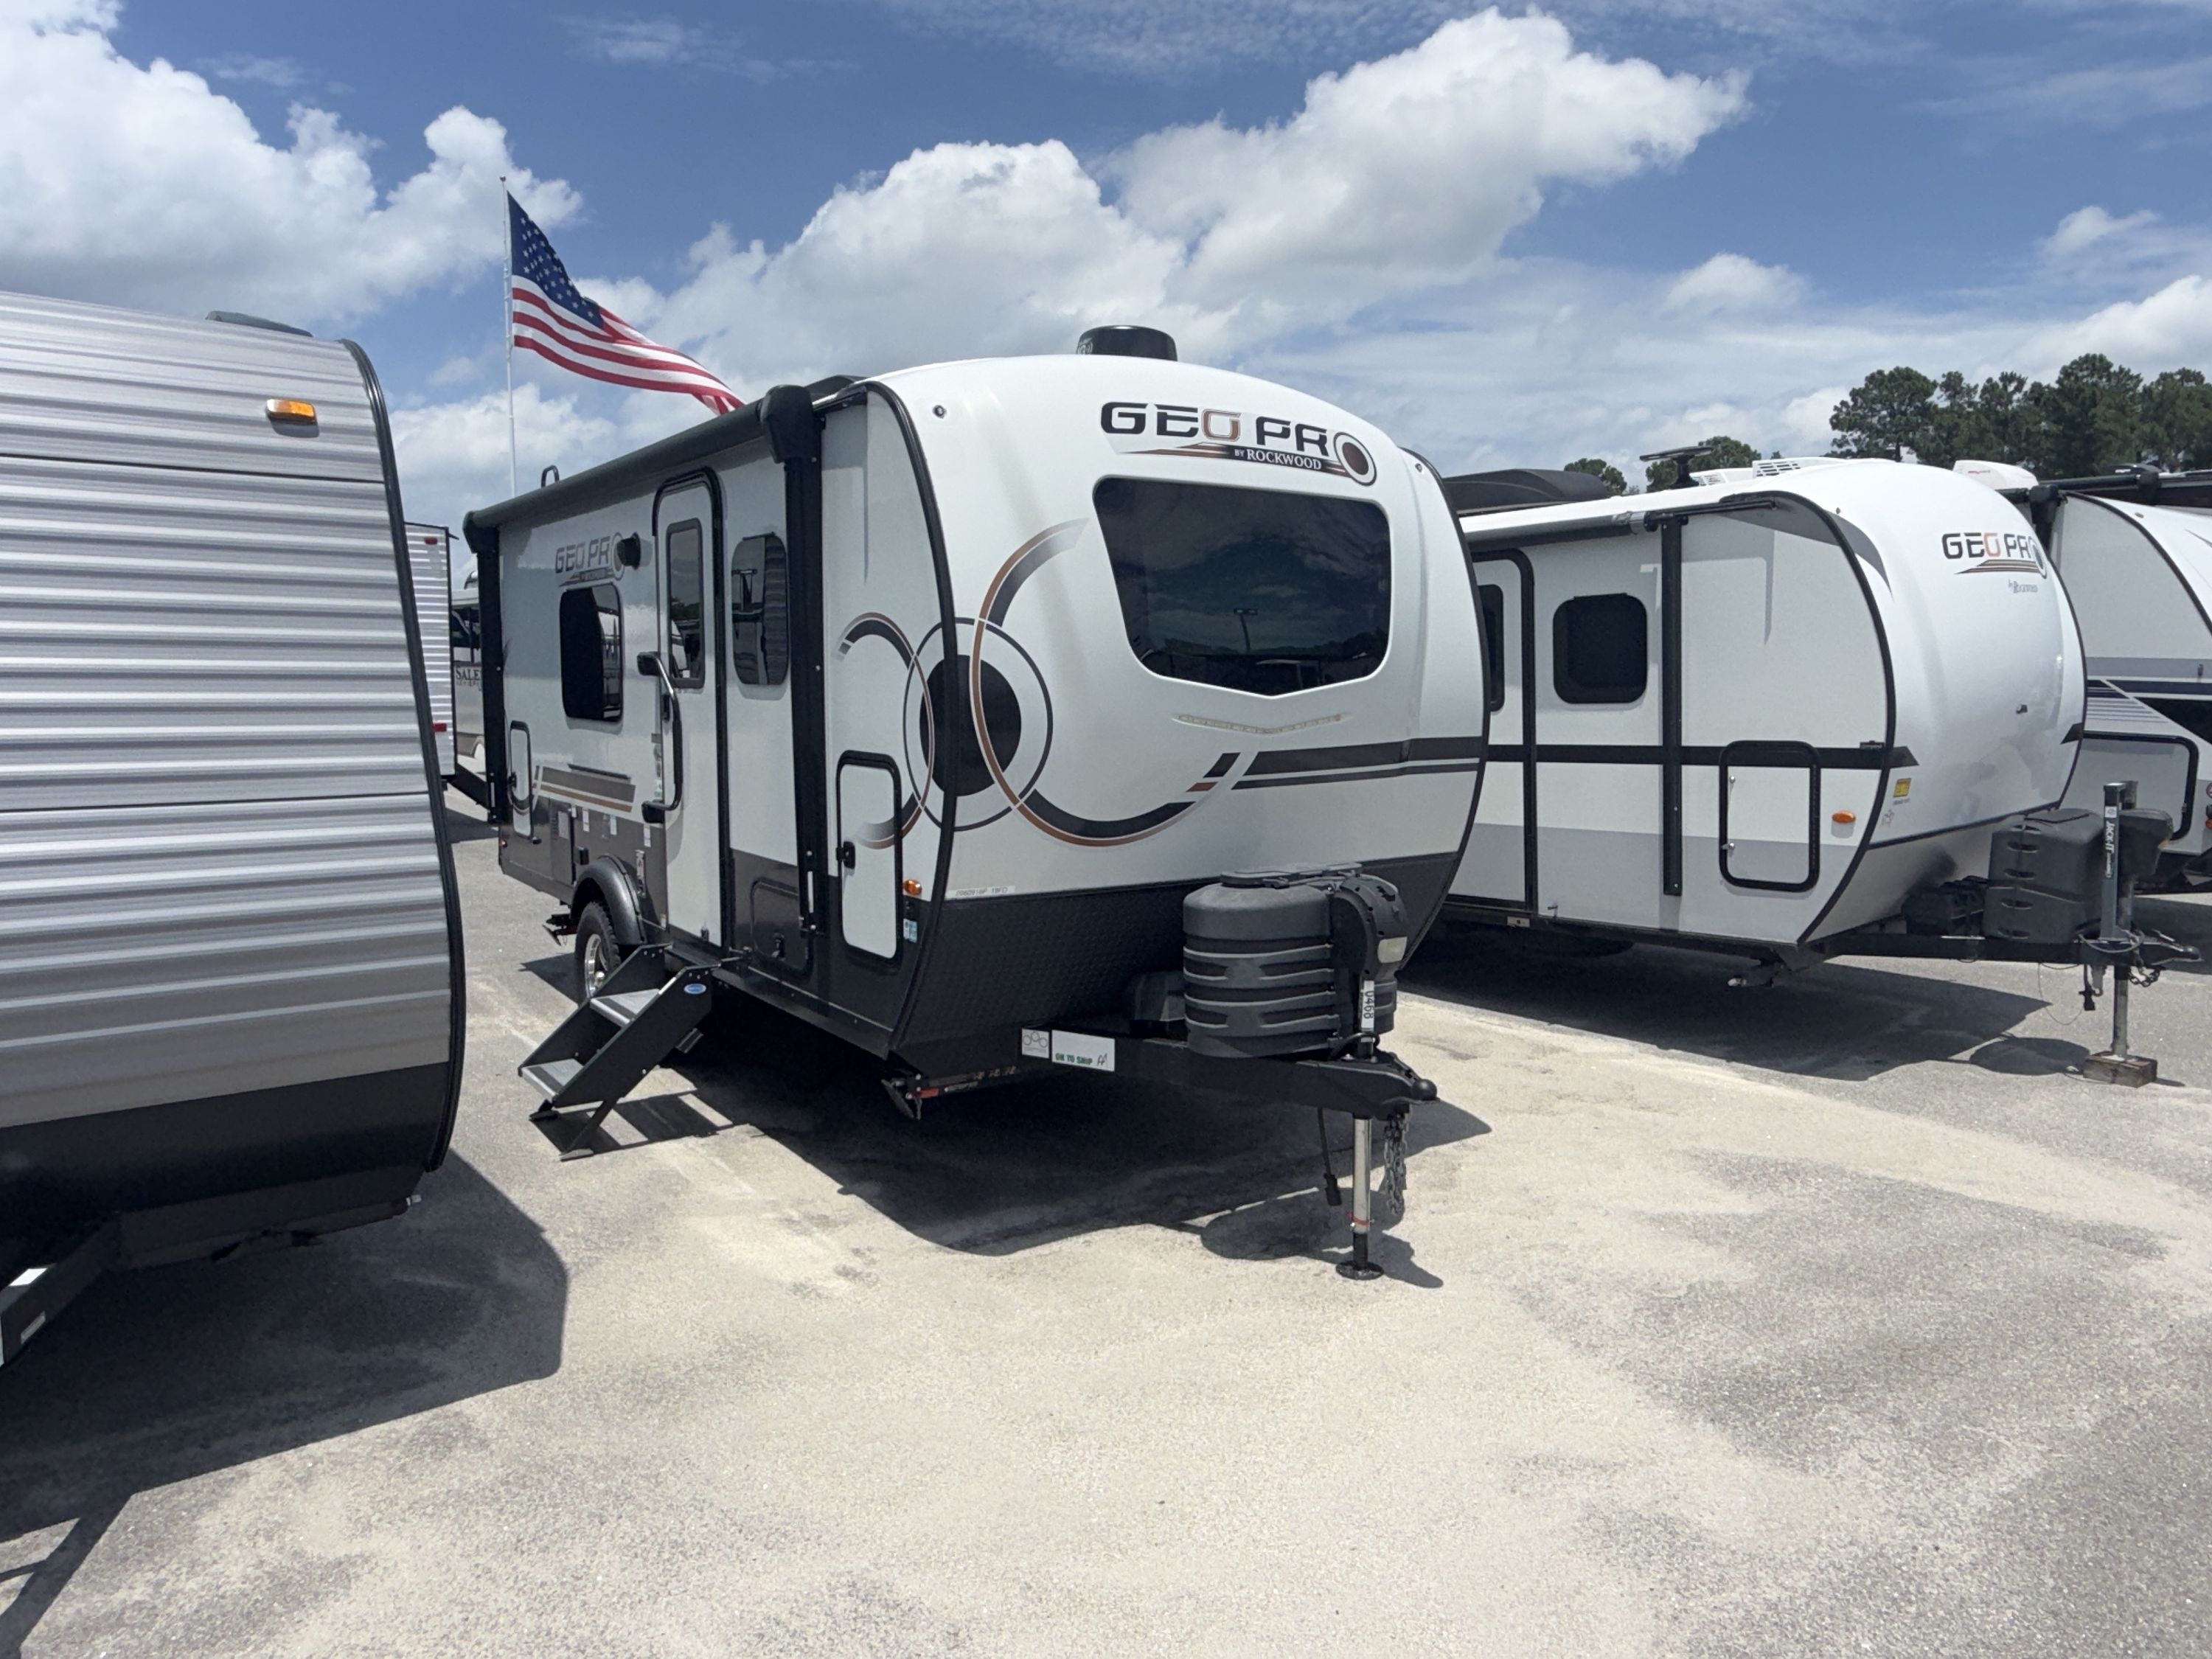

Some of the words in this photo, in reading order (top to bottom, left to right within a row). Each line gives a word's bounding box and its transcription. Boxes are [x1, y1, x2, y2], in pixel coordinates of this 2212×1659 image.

[1100, 400, 1242, 442] GEO
[1255, 416, 1377, 487] PRO
[1234, 448, 1245, 457] BY
[1246, 448, 1322, 470] ROCKWOOD
[555, 543, 585, 574] GEO
[1941, 532, 2001, 560] GEO
[1066, 1054, 1075, 1063] TO
